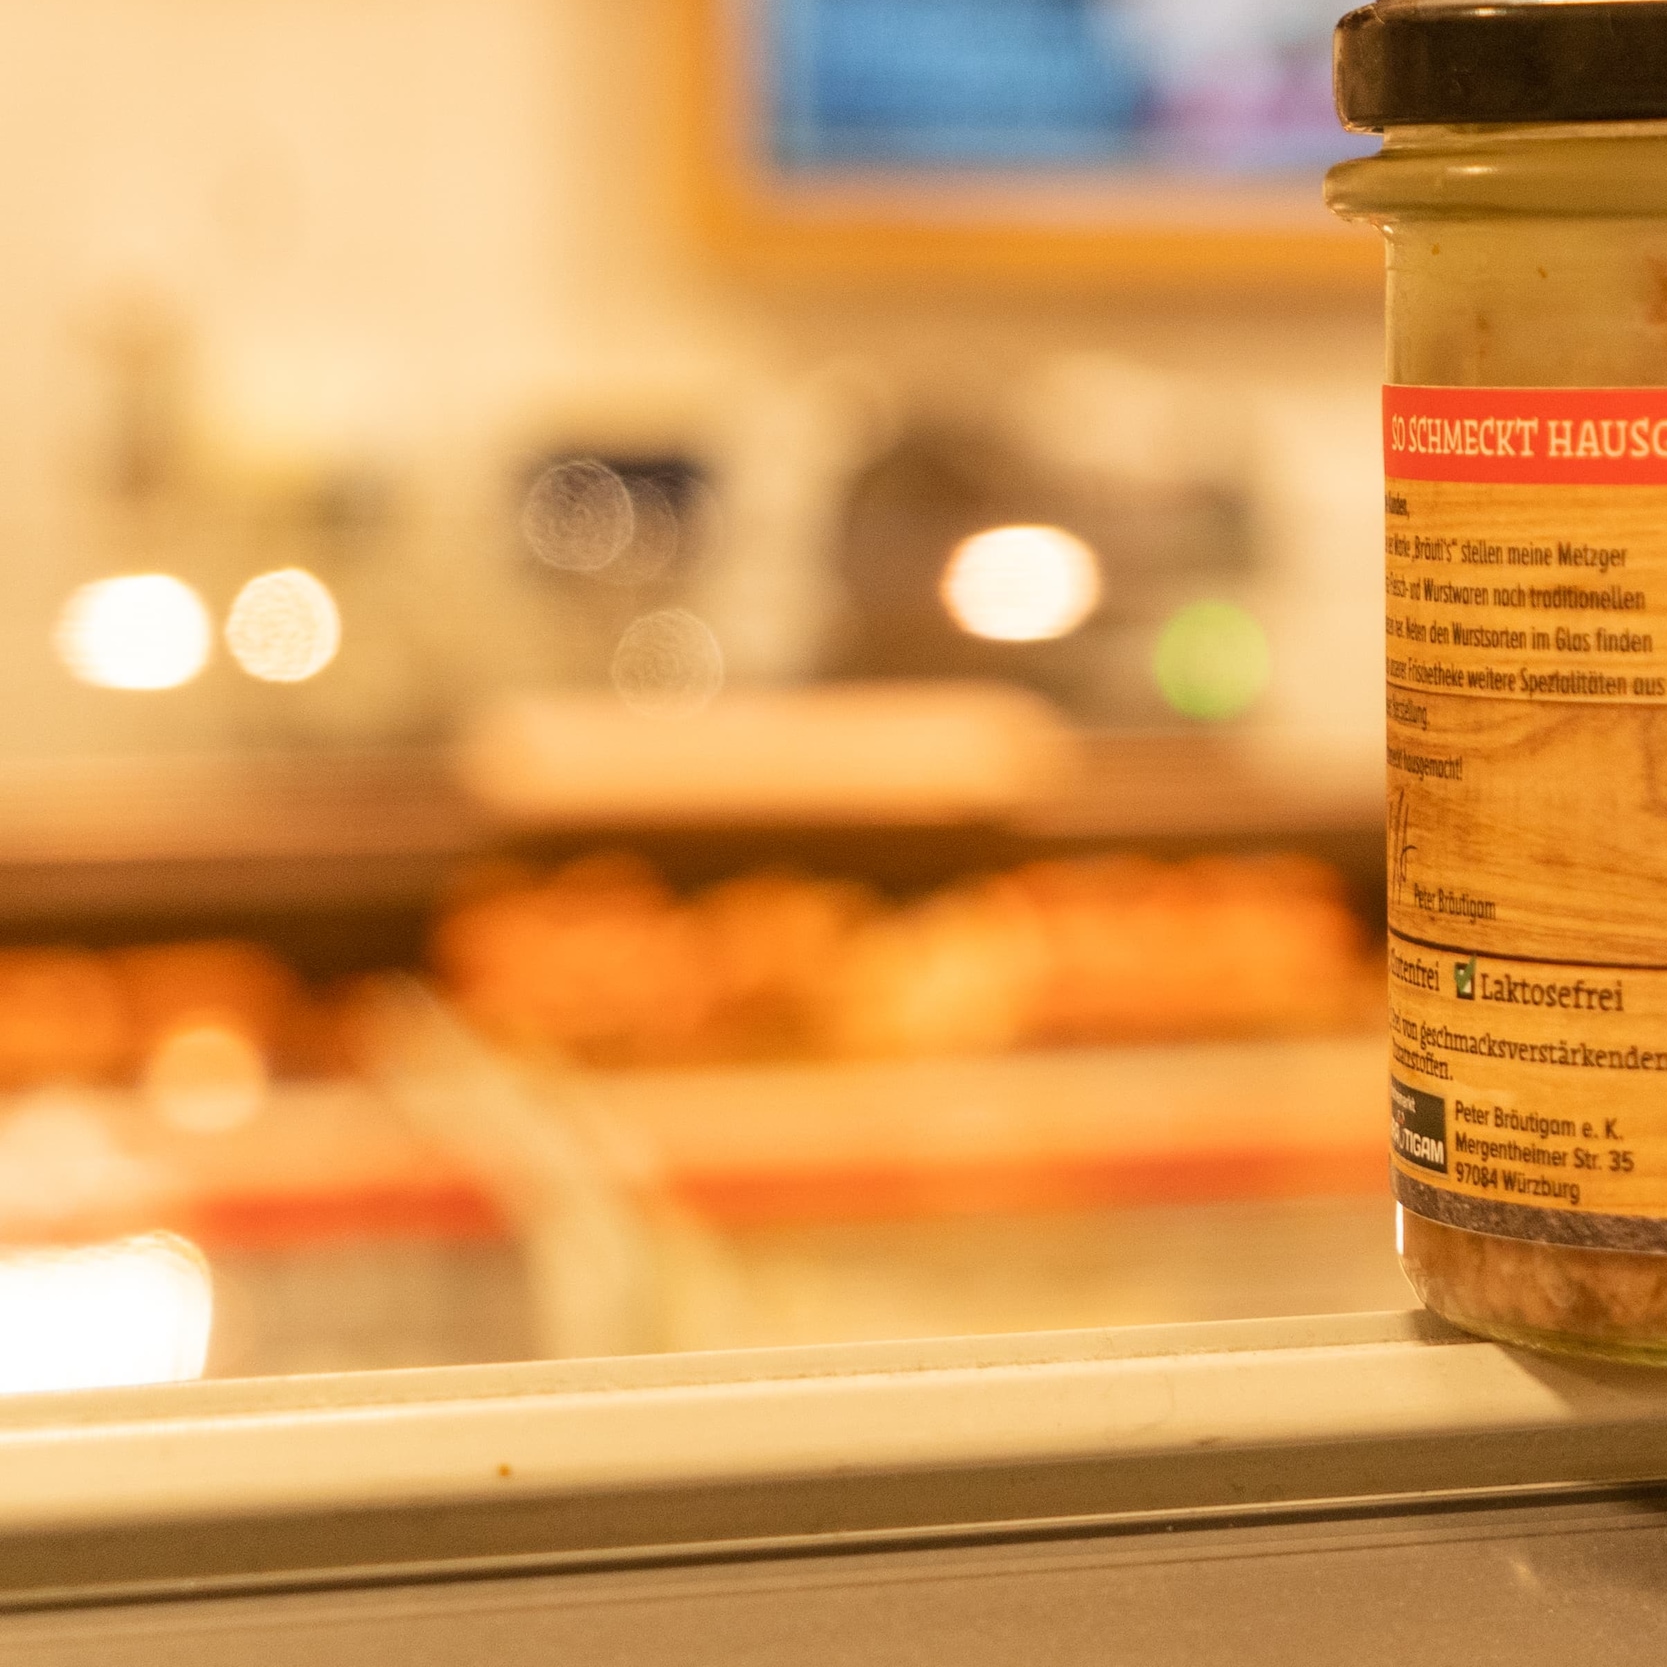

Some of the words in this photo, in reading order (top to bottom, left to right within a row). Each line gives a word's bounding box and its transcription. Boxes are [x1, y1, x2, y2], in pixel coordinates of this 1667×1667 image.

[1408, 415, 1540, 457] SCHMECKT
[1460, 538, 1504, 565] stellen
[1508, 541, 1553, 566] meine
[1557, 540, 1628, 574] Metzger
[1423, 577, 1489, 606] Wurstwaren
[1493, 582, 1526, 608] nach
[1529, 585, 1646, 611] traditionellen
[1430, 619, 1450, 645] den
[1452, 620, 1528, 650] Wurstsorten
[1532, 626, 1550, 650] im
[1555, 626, 1592, 652] Glas
[1597, 626, 1653, 653] finden
[1467, 665, 1516, 692] weitere
[1520, 667, 1628, 699] Spezialitäten
[1632, 675, 1666, 696] aus
[1413, 881, 1436, 914] Peter
[1438, 885, 1496, 924] Bräutigam
[1480, 973, 1625, 1012] Laktosefrei
[1455, 1099, 1489, 1126] Peter
[1494, 1108, 1577, 1139] Bräutigam
[1581, 1120, 1599, 1139] e.
[1605, 1118, 1624, 1141] K.
[1455, 1131, 1568, 1168] Mergentheimer
[1574, 1147, 1602, 1172] Str.
[1608, 1150, 1635, 1173] 35
[1455, 1162, 1498, 1190] 97084
[1502, 1172, 1582, 1206] Würzburg
